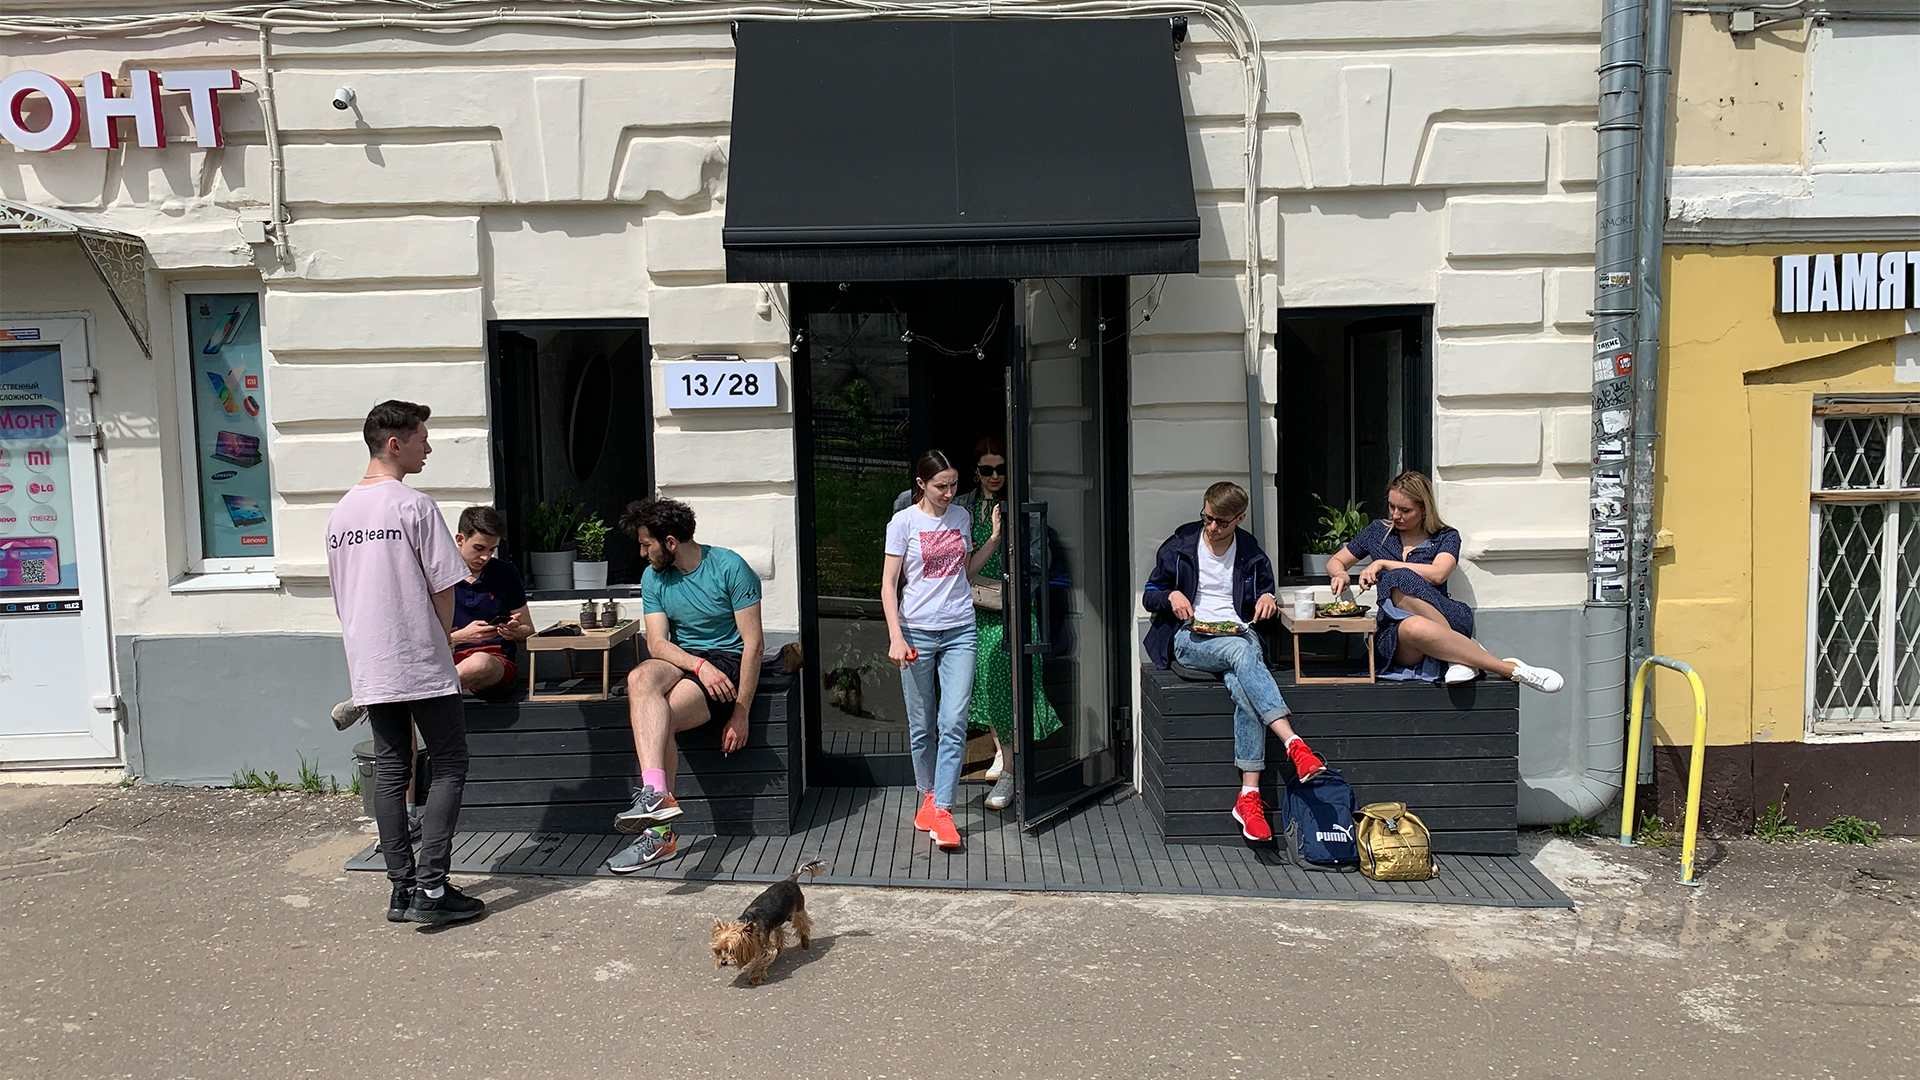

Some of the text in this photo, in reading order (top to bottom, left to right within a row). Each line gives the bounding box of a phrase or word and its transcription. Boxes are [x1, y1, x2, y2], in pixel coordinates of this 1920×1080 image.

[0, 70, 240, 150] ОНТ
[681, 373, 759, 396] 13/28
[41, 484, 54, 492] LG
[328, 529, 402, 549] 3/28 team
[1316, 831, 1348, 843] PUMA
